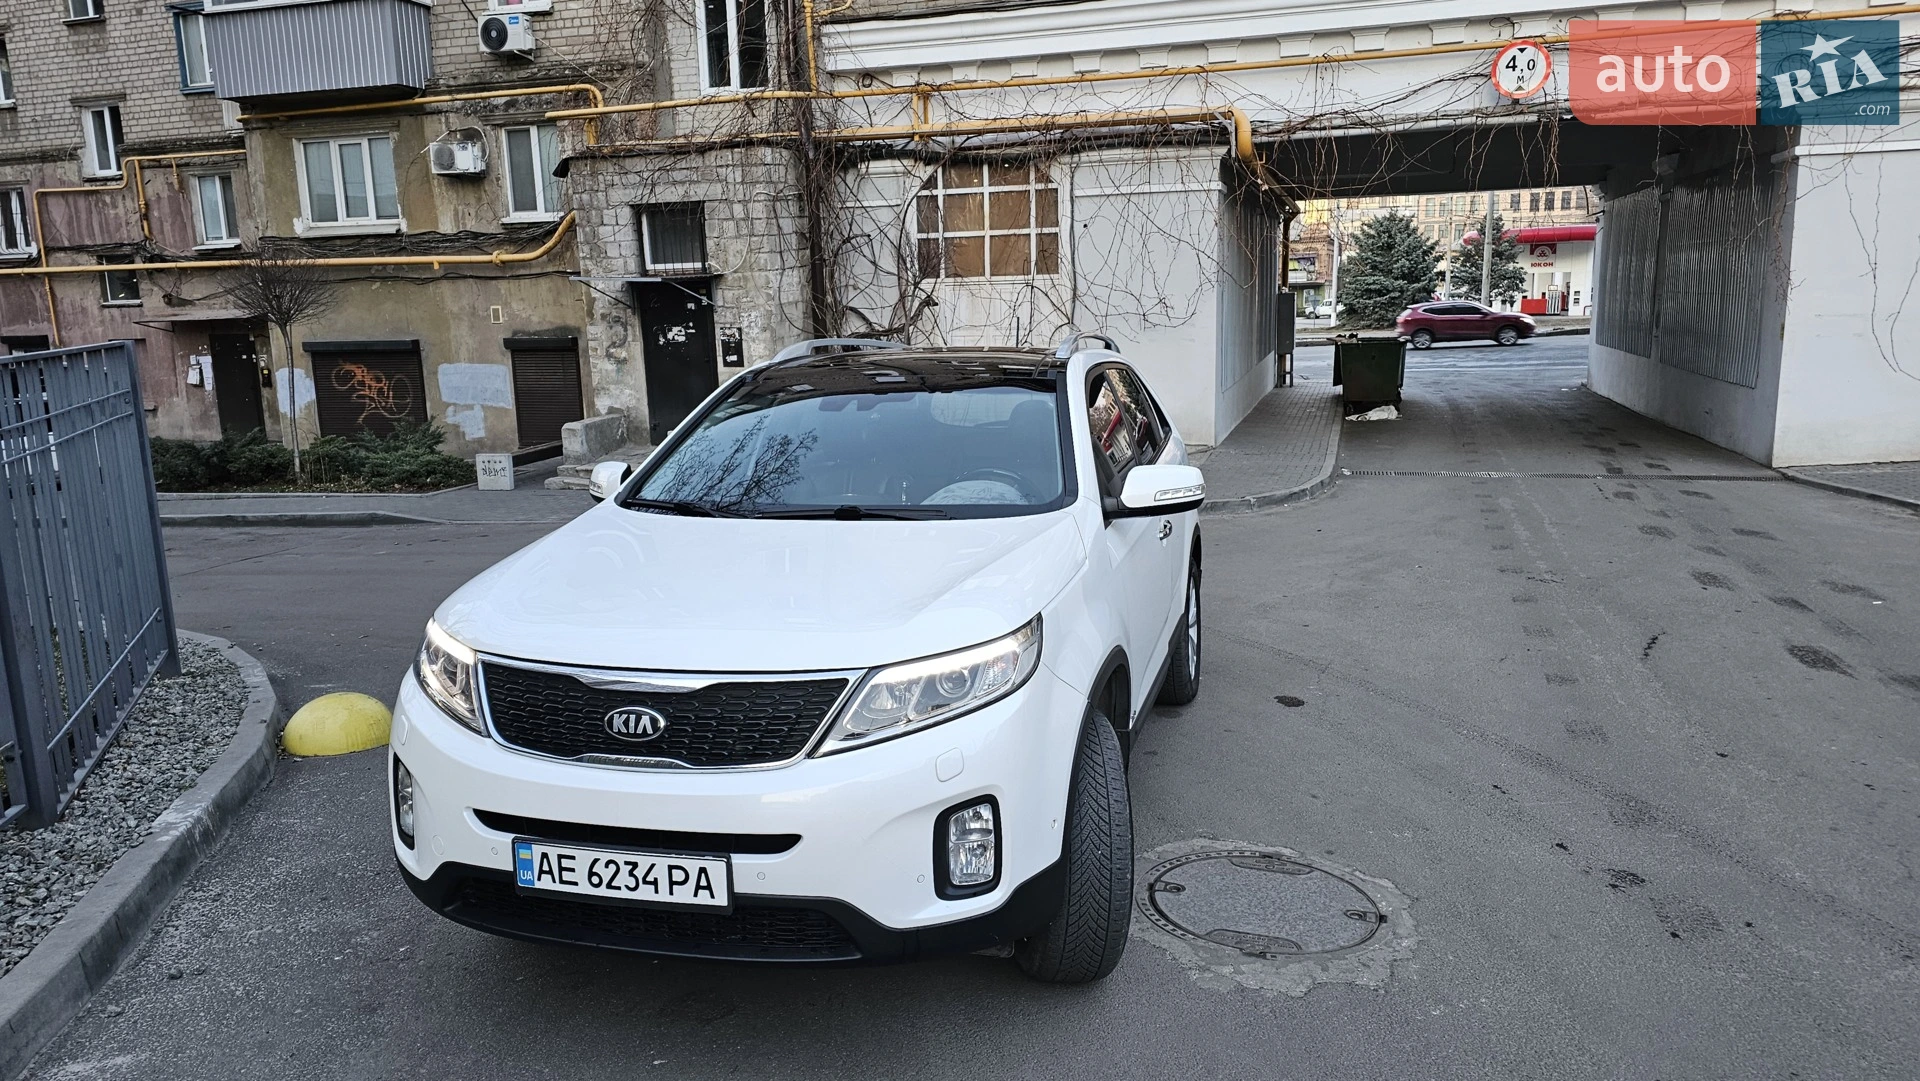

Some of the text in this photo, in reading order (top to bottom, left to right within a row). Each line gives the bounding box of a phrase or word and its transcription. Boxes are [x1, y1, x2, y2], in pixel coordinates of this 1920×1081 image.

[1505, 55, 1536, 74] 4,0
[612, 713, 654, 735] KIA
[520, 869, 534, 881] UA
[536, 851, 716, 900] AE 6234 PA
